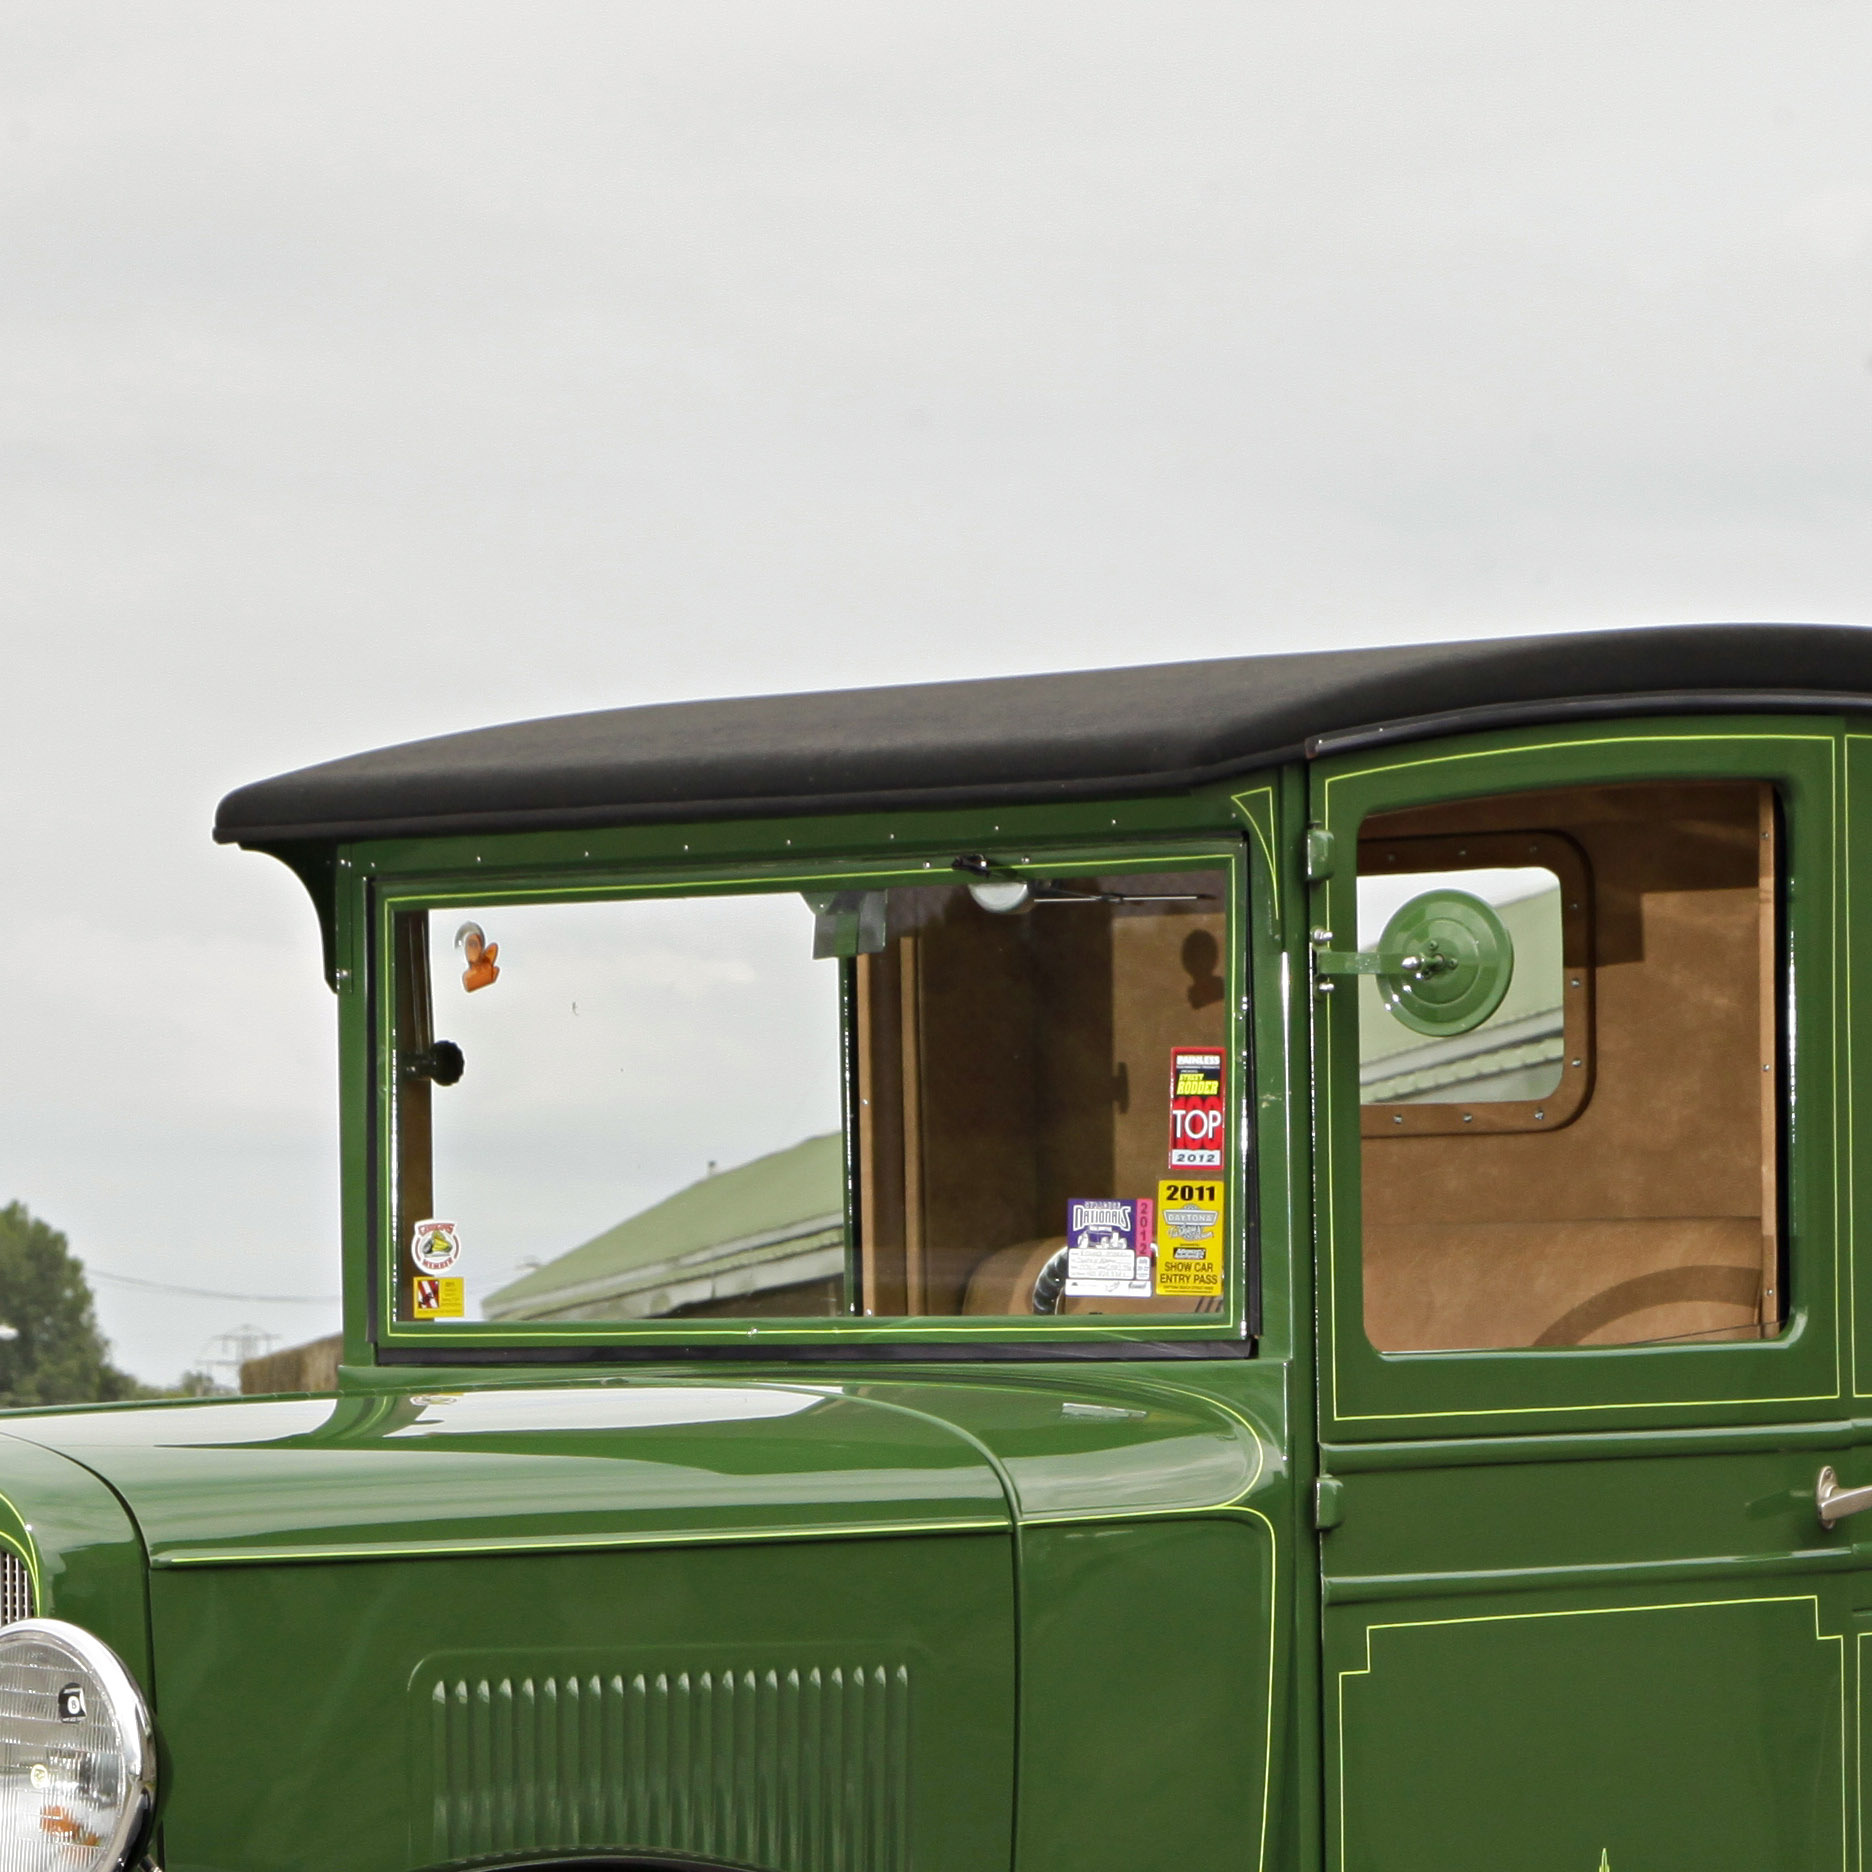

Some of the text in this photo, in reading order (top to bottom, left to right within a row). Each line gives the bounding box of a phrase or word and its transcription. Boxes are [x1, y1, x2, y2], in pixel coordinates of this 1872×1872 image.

[1176, 1080, 1219, 1095] RODDER
[1172, 1109, 1222, 1139] TOP
[1176, 1153, 1215, 1163] 2012
[1166, 1184, 1215, 1201] 2011
[1073, 1205, 1132, 1231] NATIONALS
[1168, 1213, 1214, 1222] DAYTONA
[1164, 1261, 1213, 1273] SHOW CAR
[1160, 1273, 1218, 1285] ENTRY PASS
